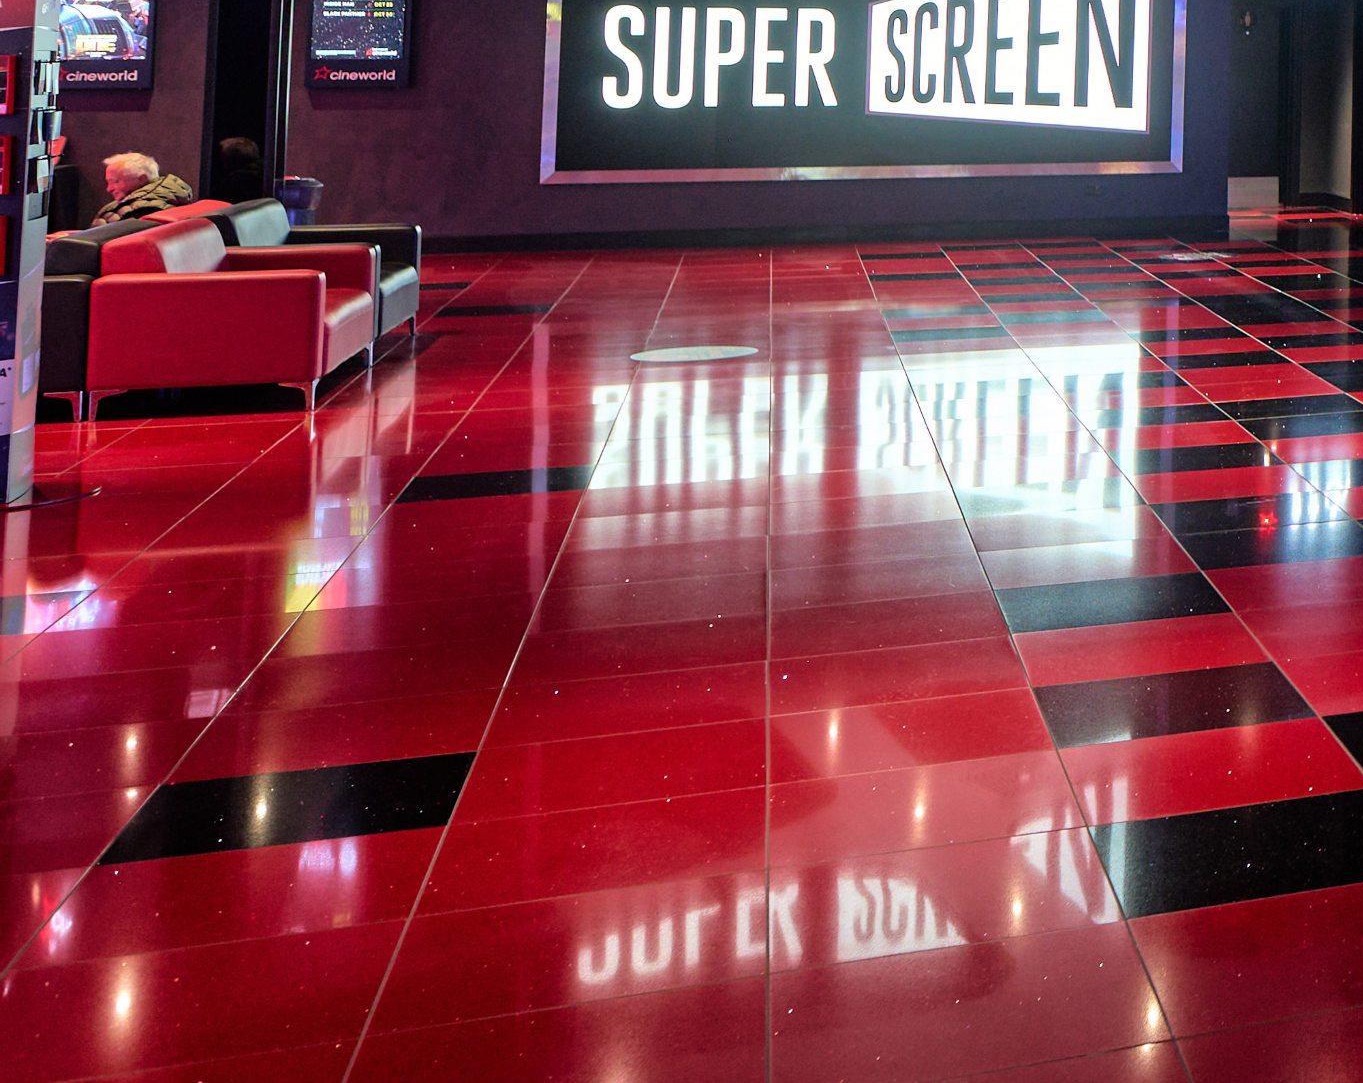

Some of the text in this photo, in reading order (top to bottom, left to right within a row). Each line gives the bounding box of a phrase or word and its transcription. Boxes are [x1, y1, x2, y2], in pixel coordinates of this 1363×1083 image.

[602, 3, 838, 110] SUPER
[66, 70, 138, 82] cineworld
[330, 70, 395, 81] cineworld
